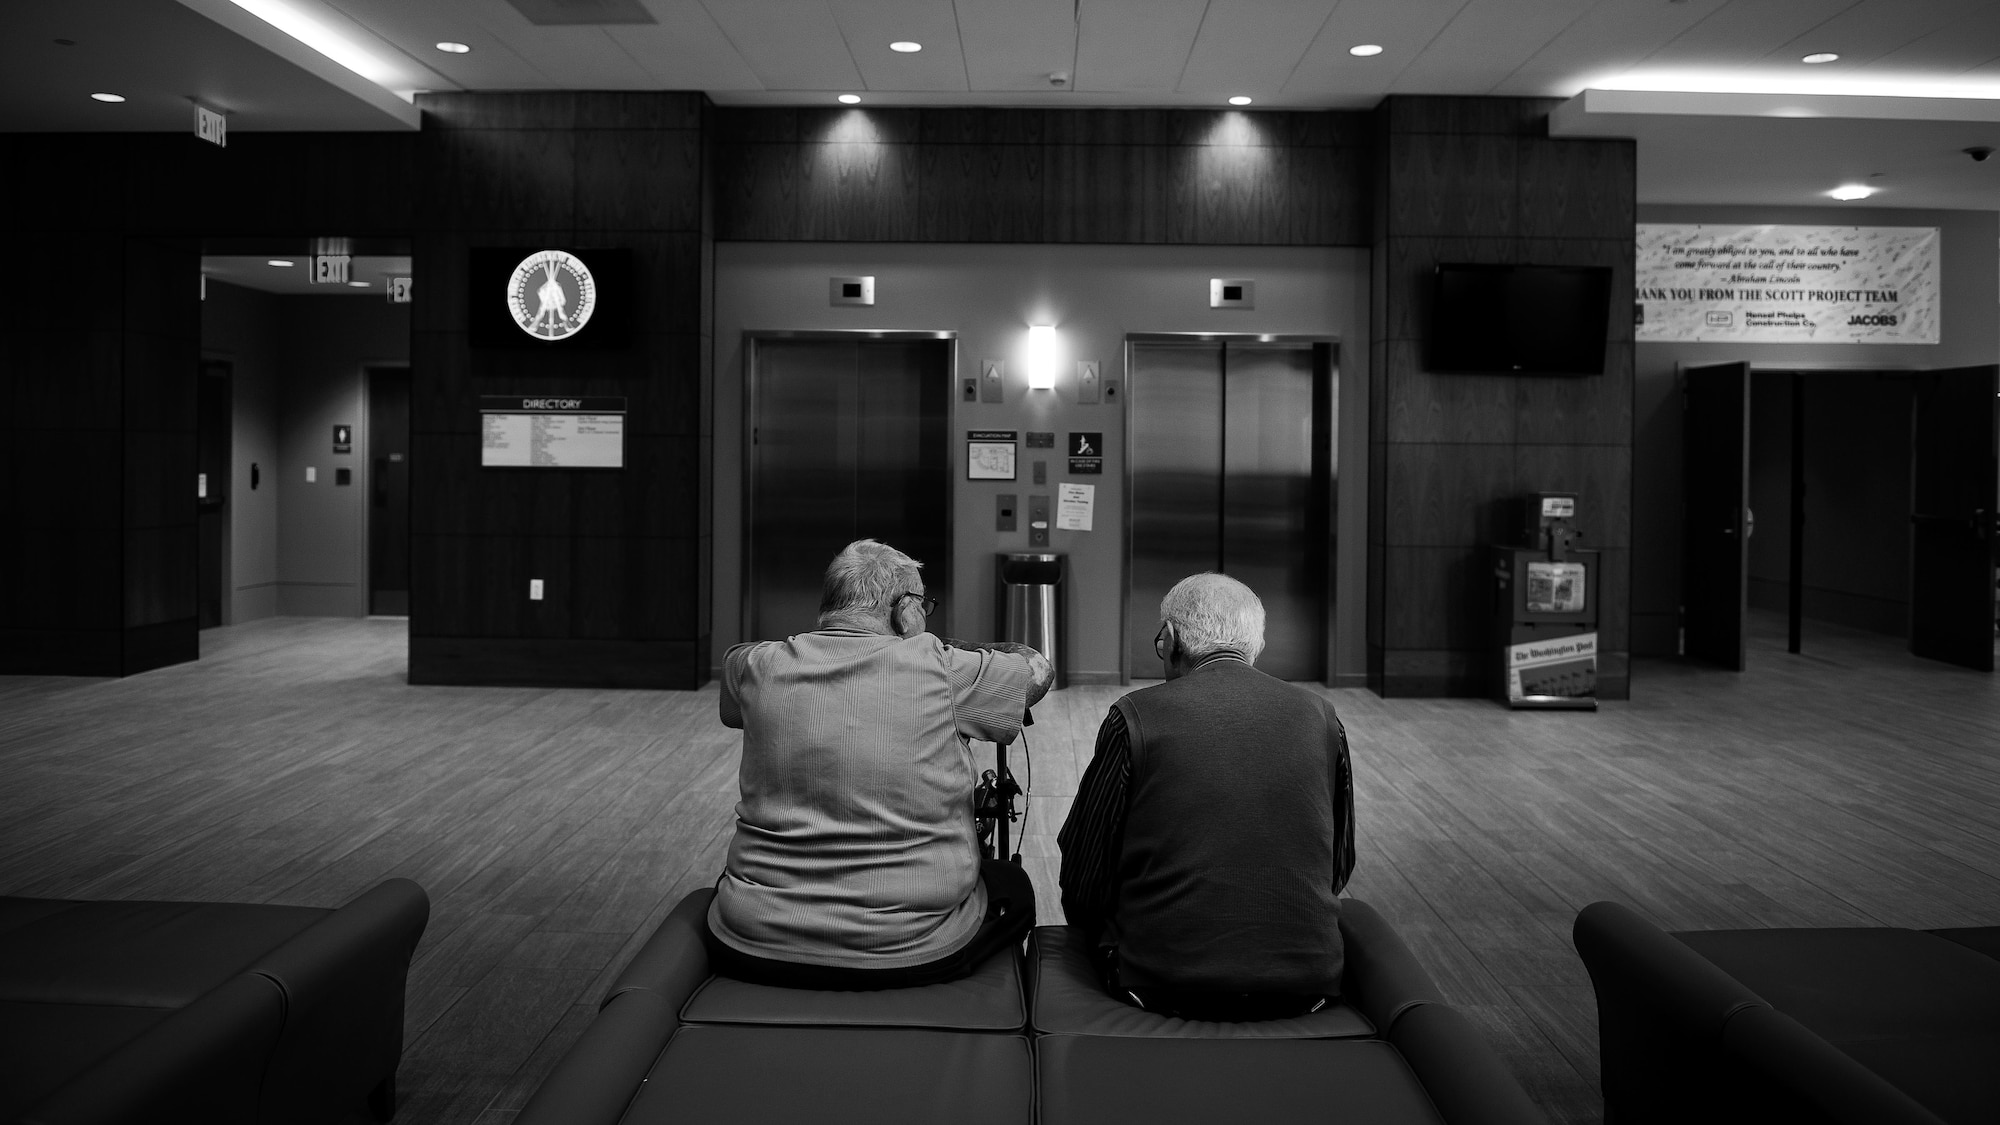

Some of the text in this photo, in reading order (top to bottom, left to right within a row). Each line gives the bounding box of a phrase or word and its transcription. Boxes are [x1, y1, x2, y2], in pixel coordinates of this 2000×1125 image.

[198, 107, 221, 145] EXIT
[1672, 246, 1685, 255] am
[1686, 245, 1716, 258] greatly
[1717, 244, 1747, 257] obliged
[1748, 246, 1758, 255] to
[1759, 246, 1777, 258] you,
[1778, 245, 1794, 256] and
[1796, 246, 1805, 256] to
[1807, 245, 1819, 256] all
[1820, 245, 1838, 256] who
[1839, 245, 1860, 257] have
[317, 256, 351, 284] EXIT
[1674, 261, 1696, 270] come
[1696, 258, 1731, 271] forward
[1732, 260, 1741, 270] at
[1743, 259, 1757, 270] the
[1758, 259, 1774, 270] call
[1775, 259, 1786, 273] of
[1786, 259, 1806, 270] their
[1728, 274, 1767, 285] Abraham
[1769, 274, 1801, 285] Lincoln
[394, 277, 413, 303] EX
[1670, 287, 1696, 301] YOU
[1698, 288, 1735, 301] FROM
[1737, 288, 1763, 301] THE
[1765, 288, 1806, 302] SCOTT
[1808, 289, 1862, 304] PROJECT
[1863, 290, 1898, 303] TEAM
[1777, 311, 1806, 320] Phelps
[1847, 314, 1898, 327] JACOBS
[1745, 319, 1800, 328] Construction
[523, 398, 582, 410] DIRECTORY
[1515, 641, 1594, 661] The Washington Post
